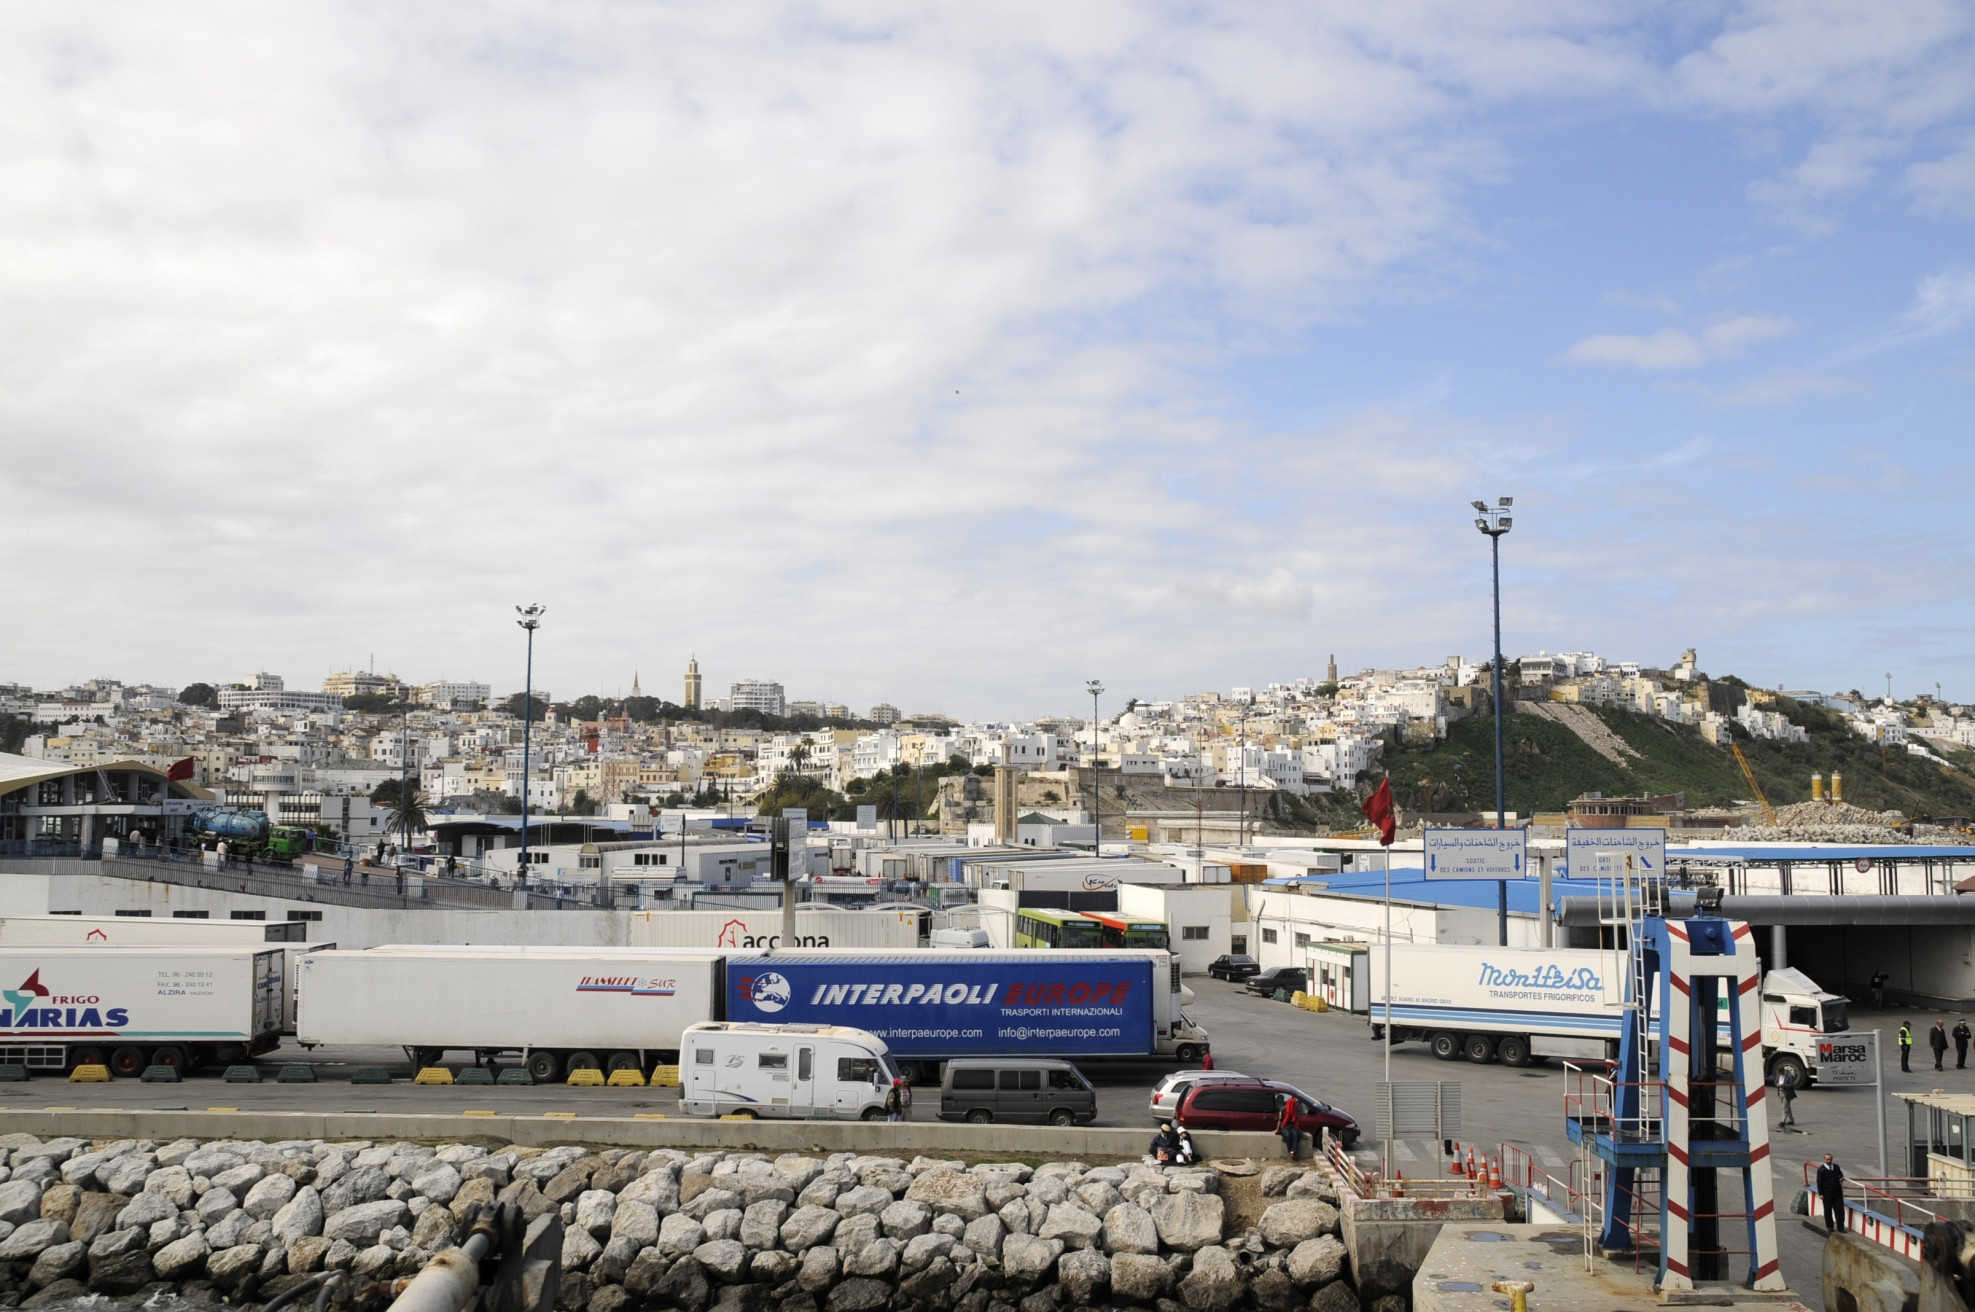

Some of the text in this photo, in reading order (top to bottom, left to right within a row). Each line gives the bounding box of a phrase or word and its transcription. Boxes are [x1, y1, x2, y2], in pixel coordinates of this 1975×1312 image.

[743, 931, 830, 948] accna
[810, 981, 1132, 1006] INTERPAOLI EUROPE
[1489, 990, 1596, 1002] TRANSPORTES FRIGORIFICOS
[52, 995, 100, 1005] FRIGO
[1000, 1008, 1123, 1016] TRASPORTI INTERNAZIONALI
[866, 1026, 1120, 1040] ww.interpaeurope.com info@interpaeurope.com
[1819, 1043, 1866, 1054] Marsa
[1820, 1053, 1866, 1063] Maroc
